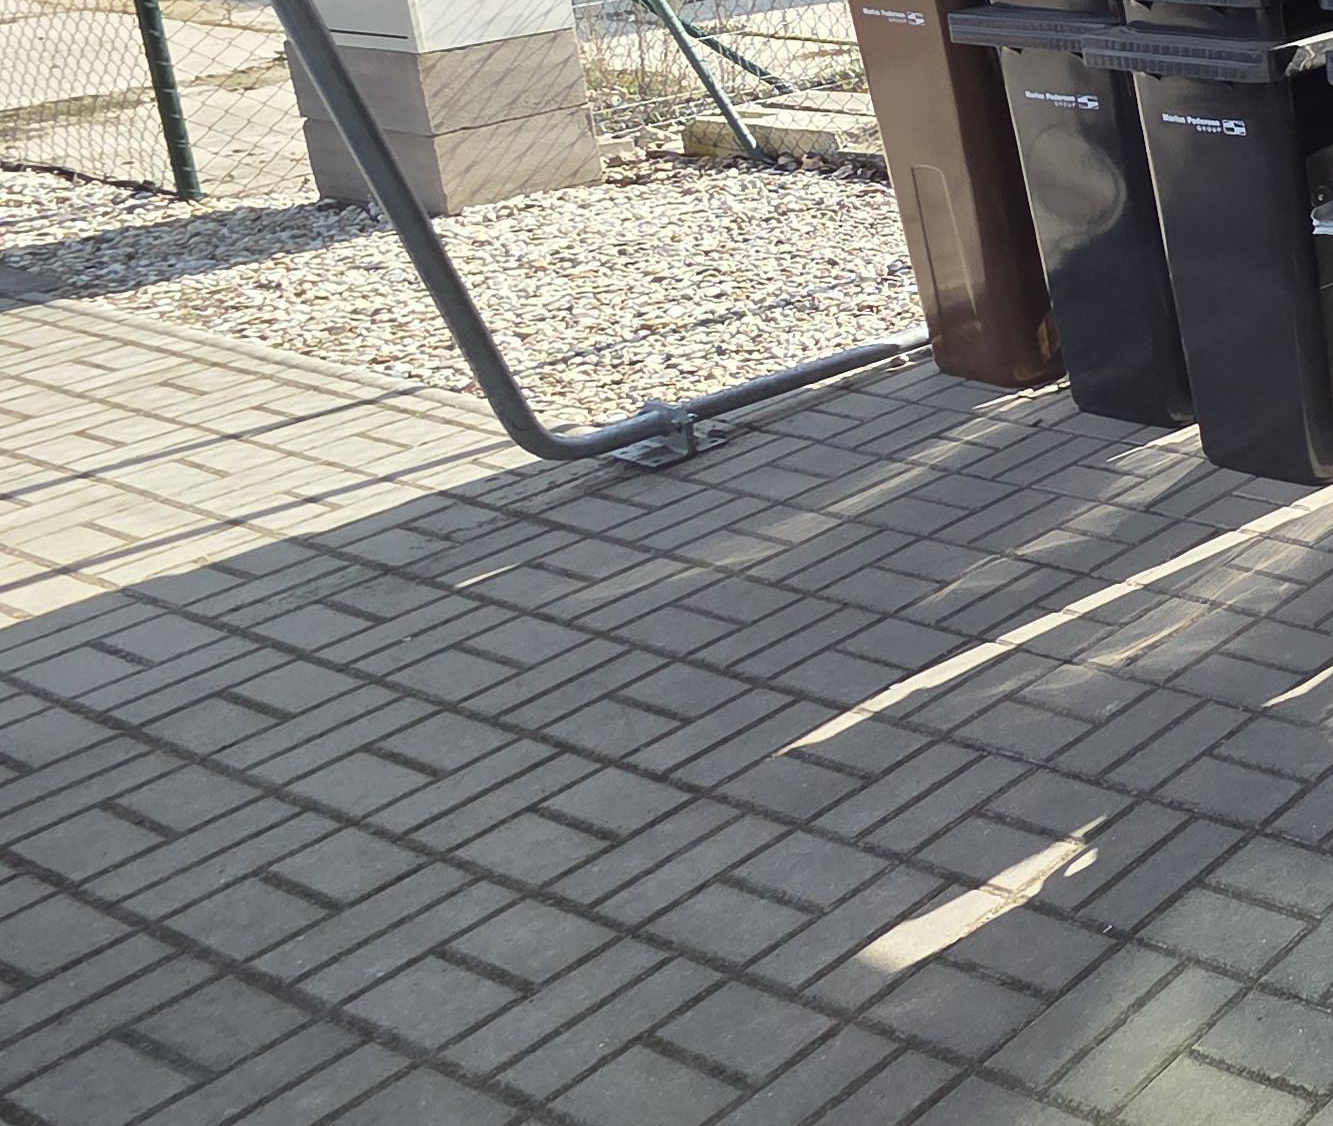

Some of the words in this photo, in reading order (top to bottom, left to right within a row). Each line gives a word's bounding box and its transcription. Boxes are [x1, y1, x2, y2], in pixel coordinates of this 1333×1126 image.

[1025, 90, 1045, 100] Marius
[1046, 92, 1076, 102] Pedersen
[1162, 113, 1185, 124] Marius
[1187, 115, 1220, 126] Pedersen
[1196, 124, 1221, 133] GROUP
